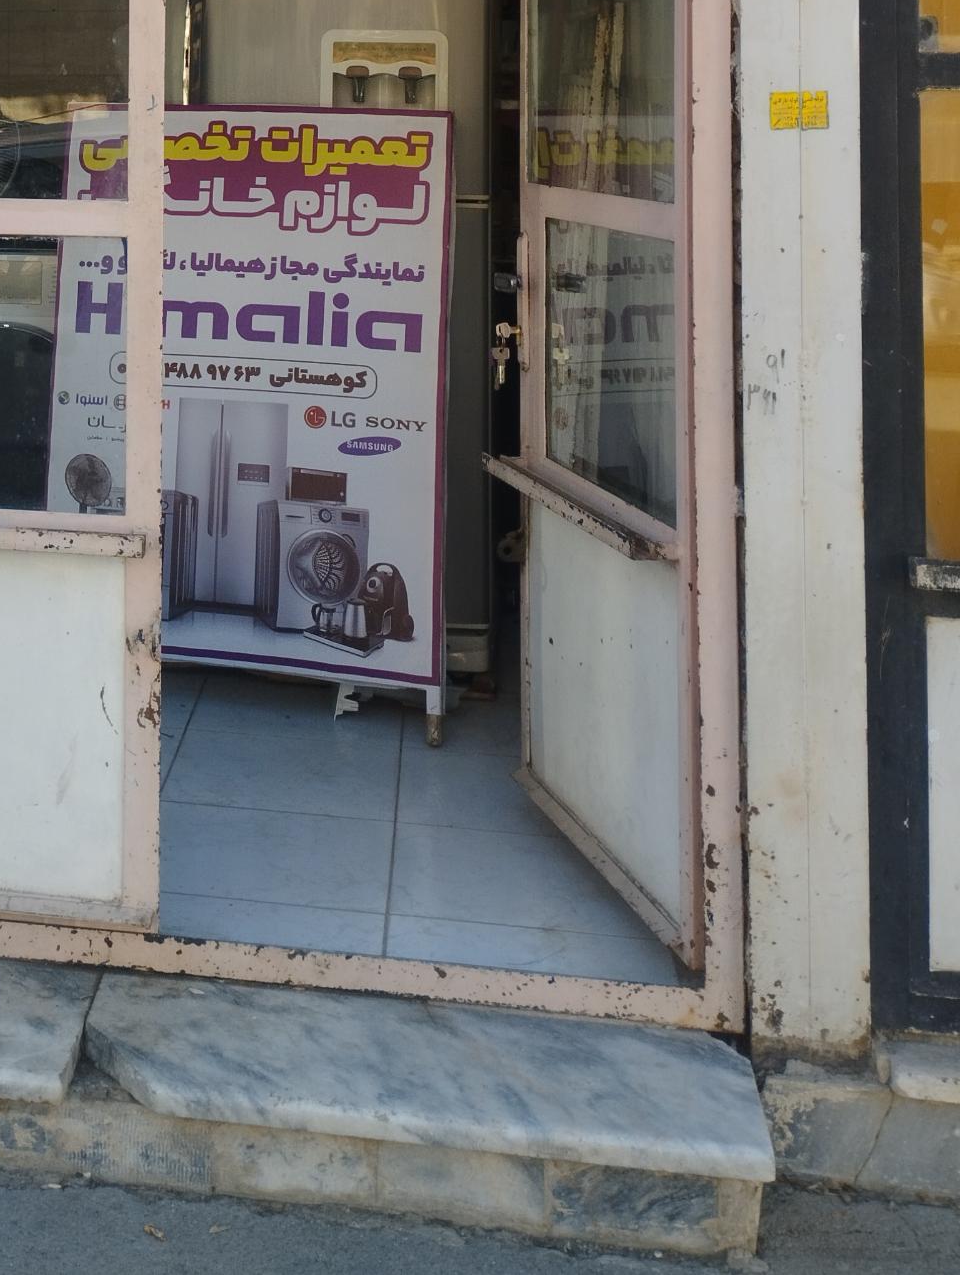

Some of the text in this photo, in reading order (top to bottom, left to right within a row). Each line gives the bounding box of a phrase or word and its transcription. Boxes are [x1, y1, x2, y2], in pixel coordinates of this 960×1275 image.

[82, 123, 431, 174] تعمیرات تخصی
[279, 181, 427, 233] لوازم
[265, 255, 319, 282] مجاز
[324, 253, 425, 284] نمایندگی
[75, 280, 422, 354] Hmalia
[269, 362, 368, 394] کوهستانی
[75, 392, 109, 407] اسنوا
[330, 410, 428, 433] LG SONY
[346, 440, 394, 453] SAMSUNG
